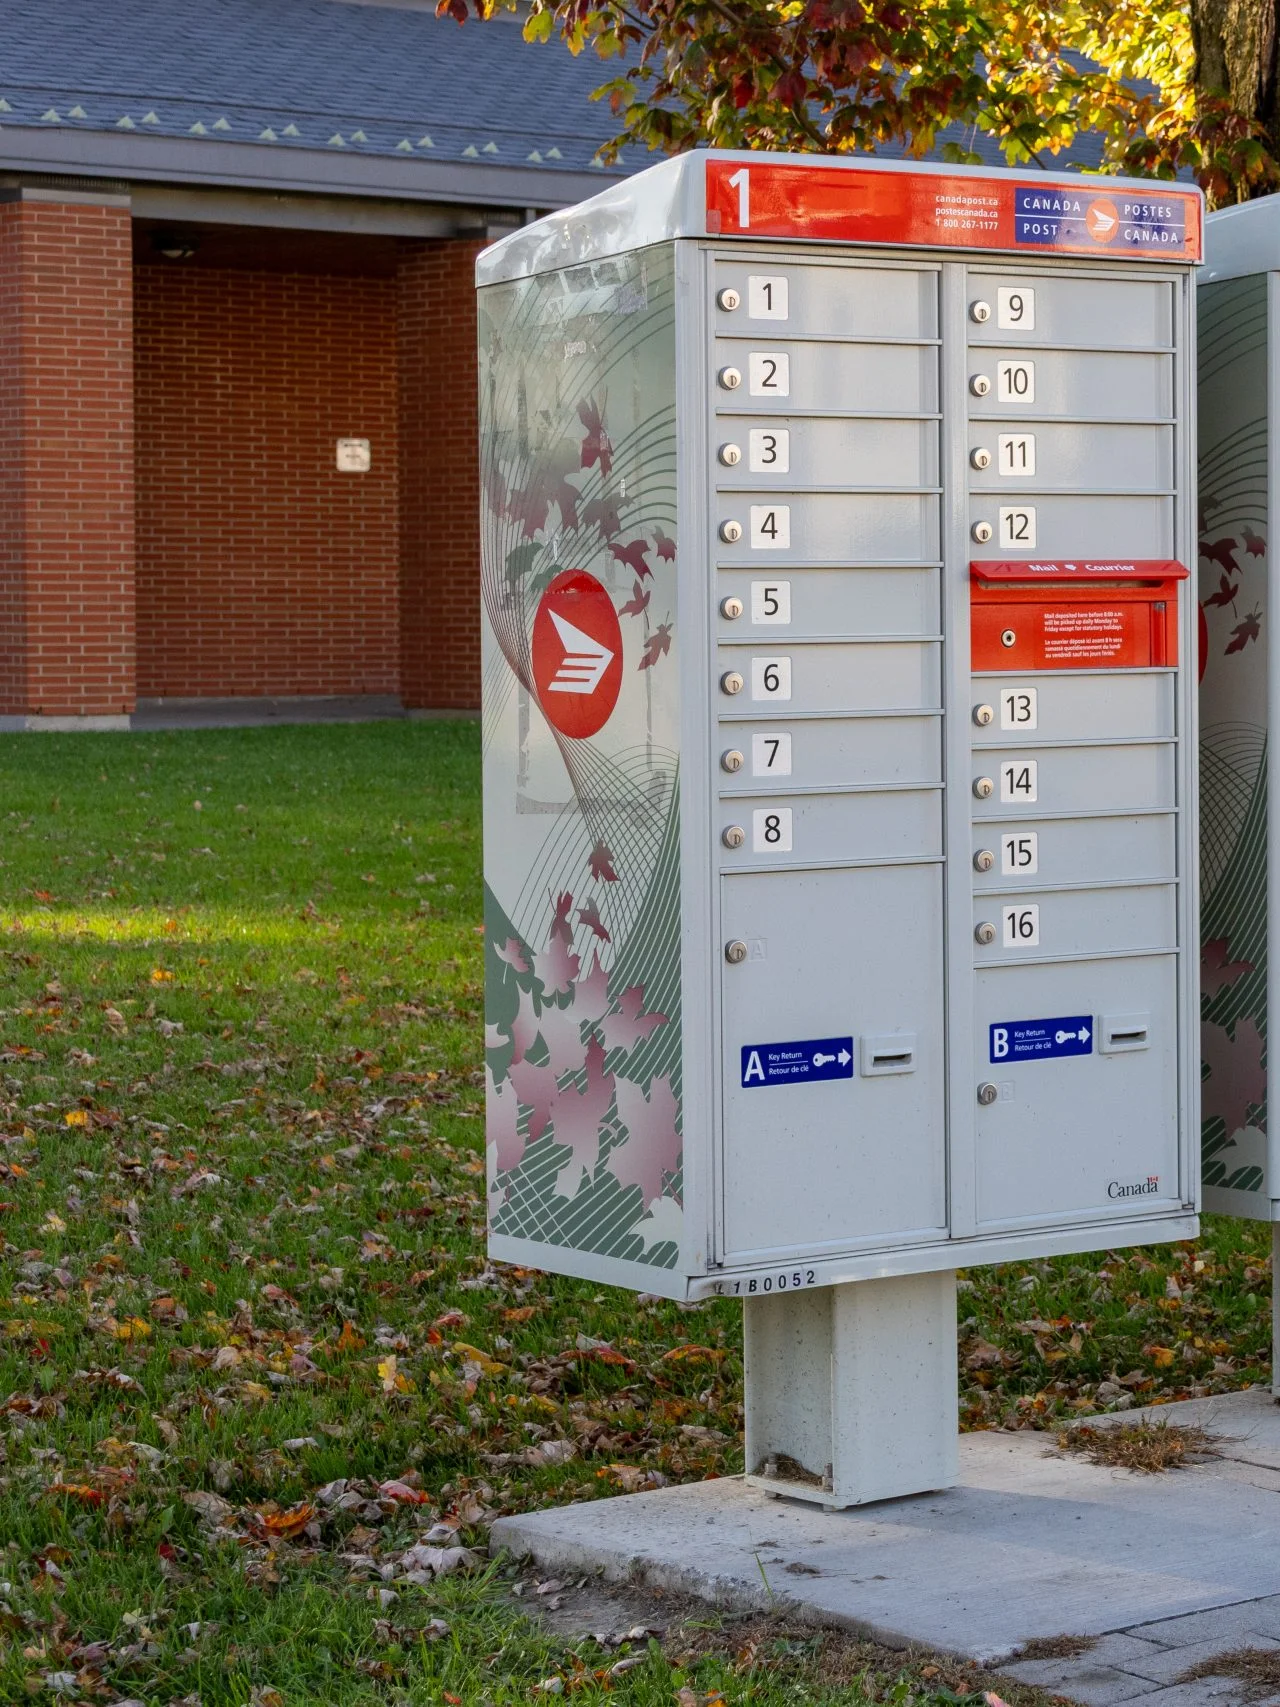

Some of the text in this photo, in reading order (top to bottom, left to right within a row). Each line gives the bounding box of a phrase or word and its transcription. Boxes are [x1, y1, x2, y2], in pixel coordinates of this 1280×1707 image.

[728, 169, 750, 228] 1
[936, 195, 998, 206] canadapost.ca
[1023, 198, 1081, 212] CANADA
[1124, 204, 1172, 218] POSTES
[936, 208, 998, 218] postescanada.ca
[936, 218, 998, 230] 1 800 267-1177
[1023, 223, 1058, 236] POST
[1124, 229, 1179, 243] CANADA
[762, 282, 772, 311] 1
[1009, 294, 1024, 322] 9
[761, 359, 778, 388] 2
[1003, 367, 1029, 395] 10
[761, 435, 777, 464] 3
[1005, 441, 1026, 468] 11
[760, 512, 778, 540] 4
[1005, 513, 1029, 540] 12
[1029, 563, 1136, 572] Mail Courrier
[764, 587, 779, 616] 5
[763, 663, 780, 692] 6
[1006, 694, 1031, 722] 13
[764, 739, 780, 768] 7
[1005, 767, 1032, 795] 14
[764, 814, 781, 844] 8
[1006, 839, 1032, 867] 15
[1007, 911, 1034, 939] 16
[994, 1028, 1009, 1058] B
[1026, 1029, 1045, 1037] Return
[769, 1052, 802, 1062] Key Return
[1014, 1044, 1033, 1052] Retour
[744, 1051, 765, 1082] A
[769, 1064, 809, 1075] Retour de clé
[1108, 1177, 1158, 1199] Canada
